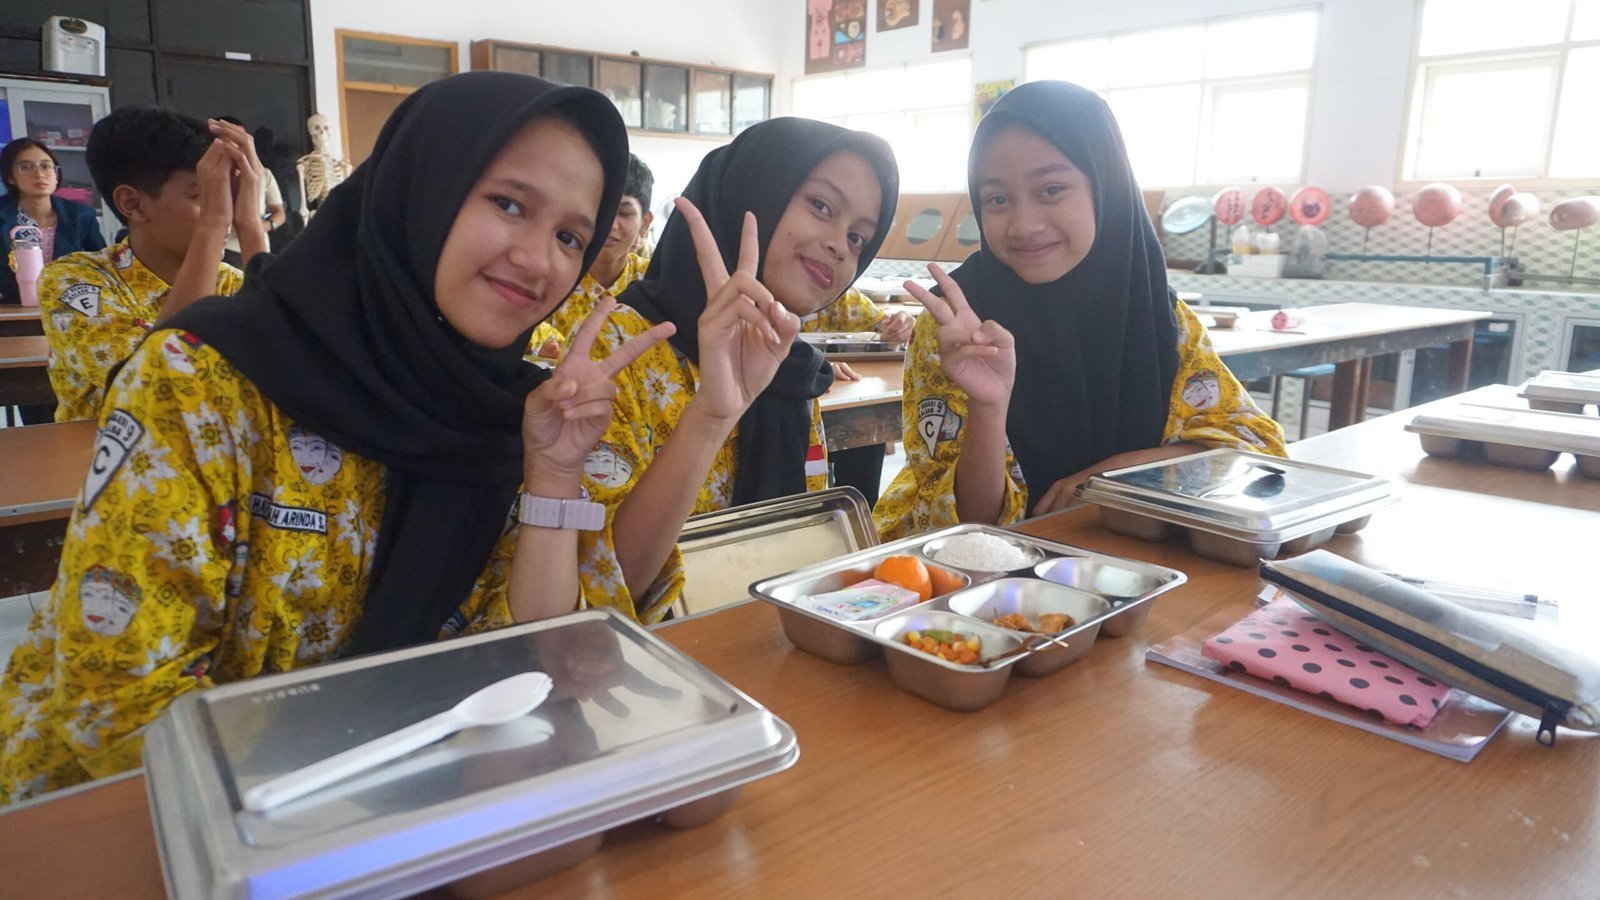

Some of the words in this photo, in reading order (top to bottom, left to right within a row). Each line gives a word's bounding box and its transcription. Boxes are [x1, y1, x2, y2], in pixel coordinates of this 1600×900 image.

[79, 297, 94, 310] E
[937, 401, 943, 413] 9
[123, 425, 135, 442] 9
[925, 420, 935, 438] C
[93, 445, 110, 475] C
[281, 510, 316, 528] ARINDA
